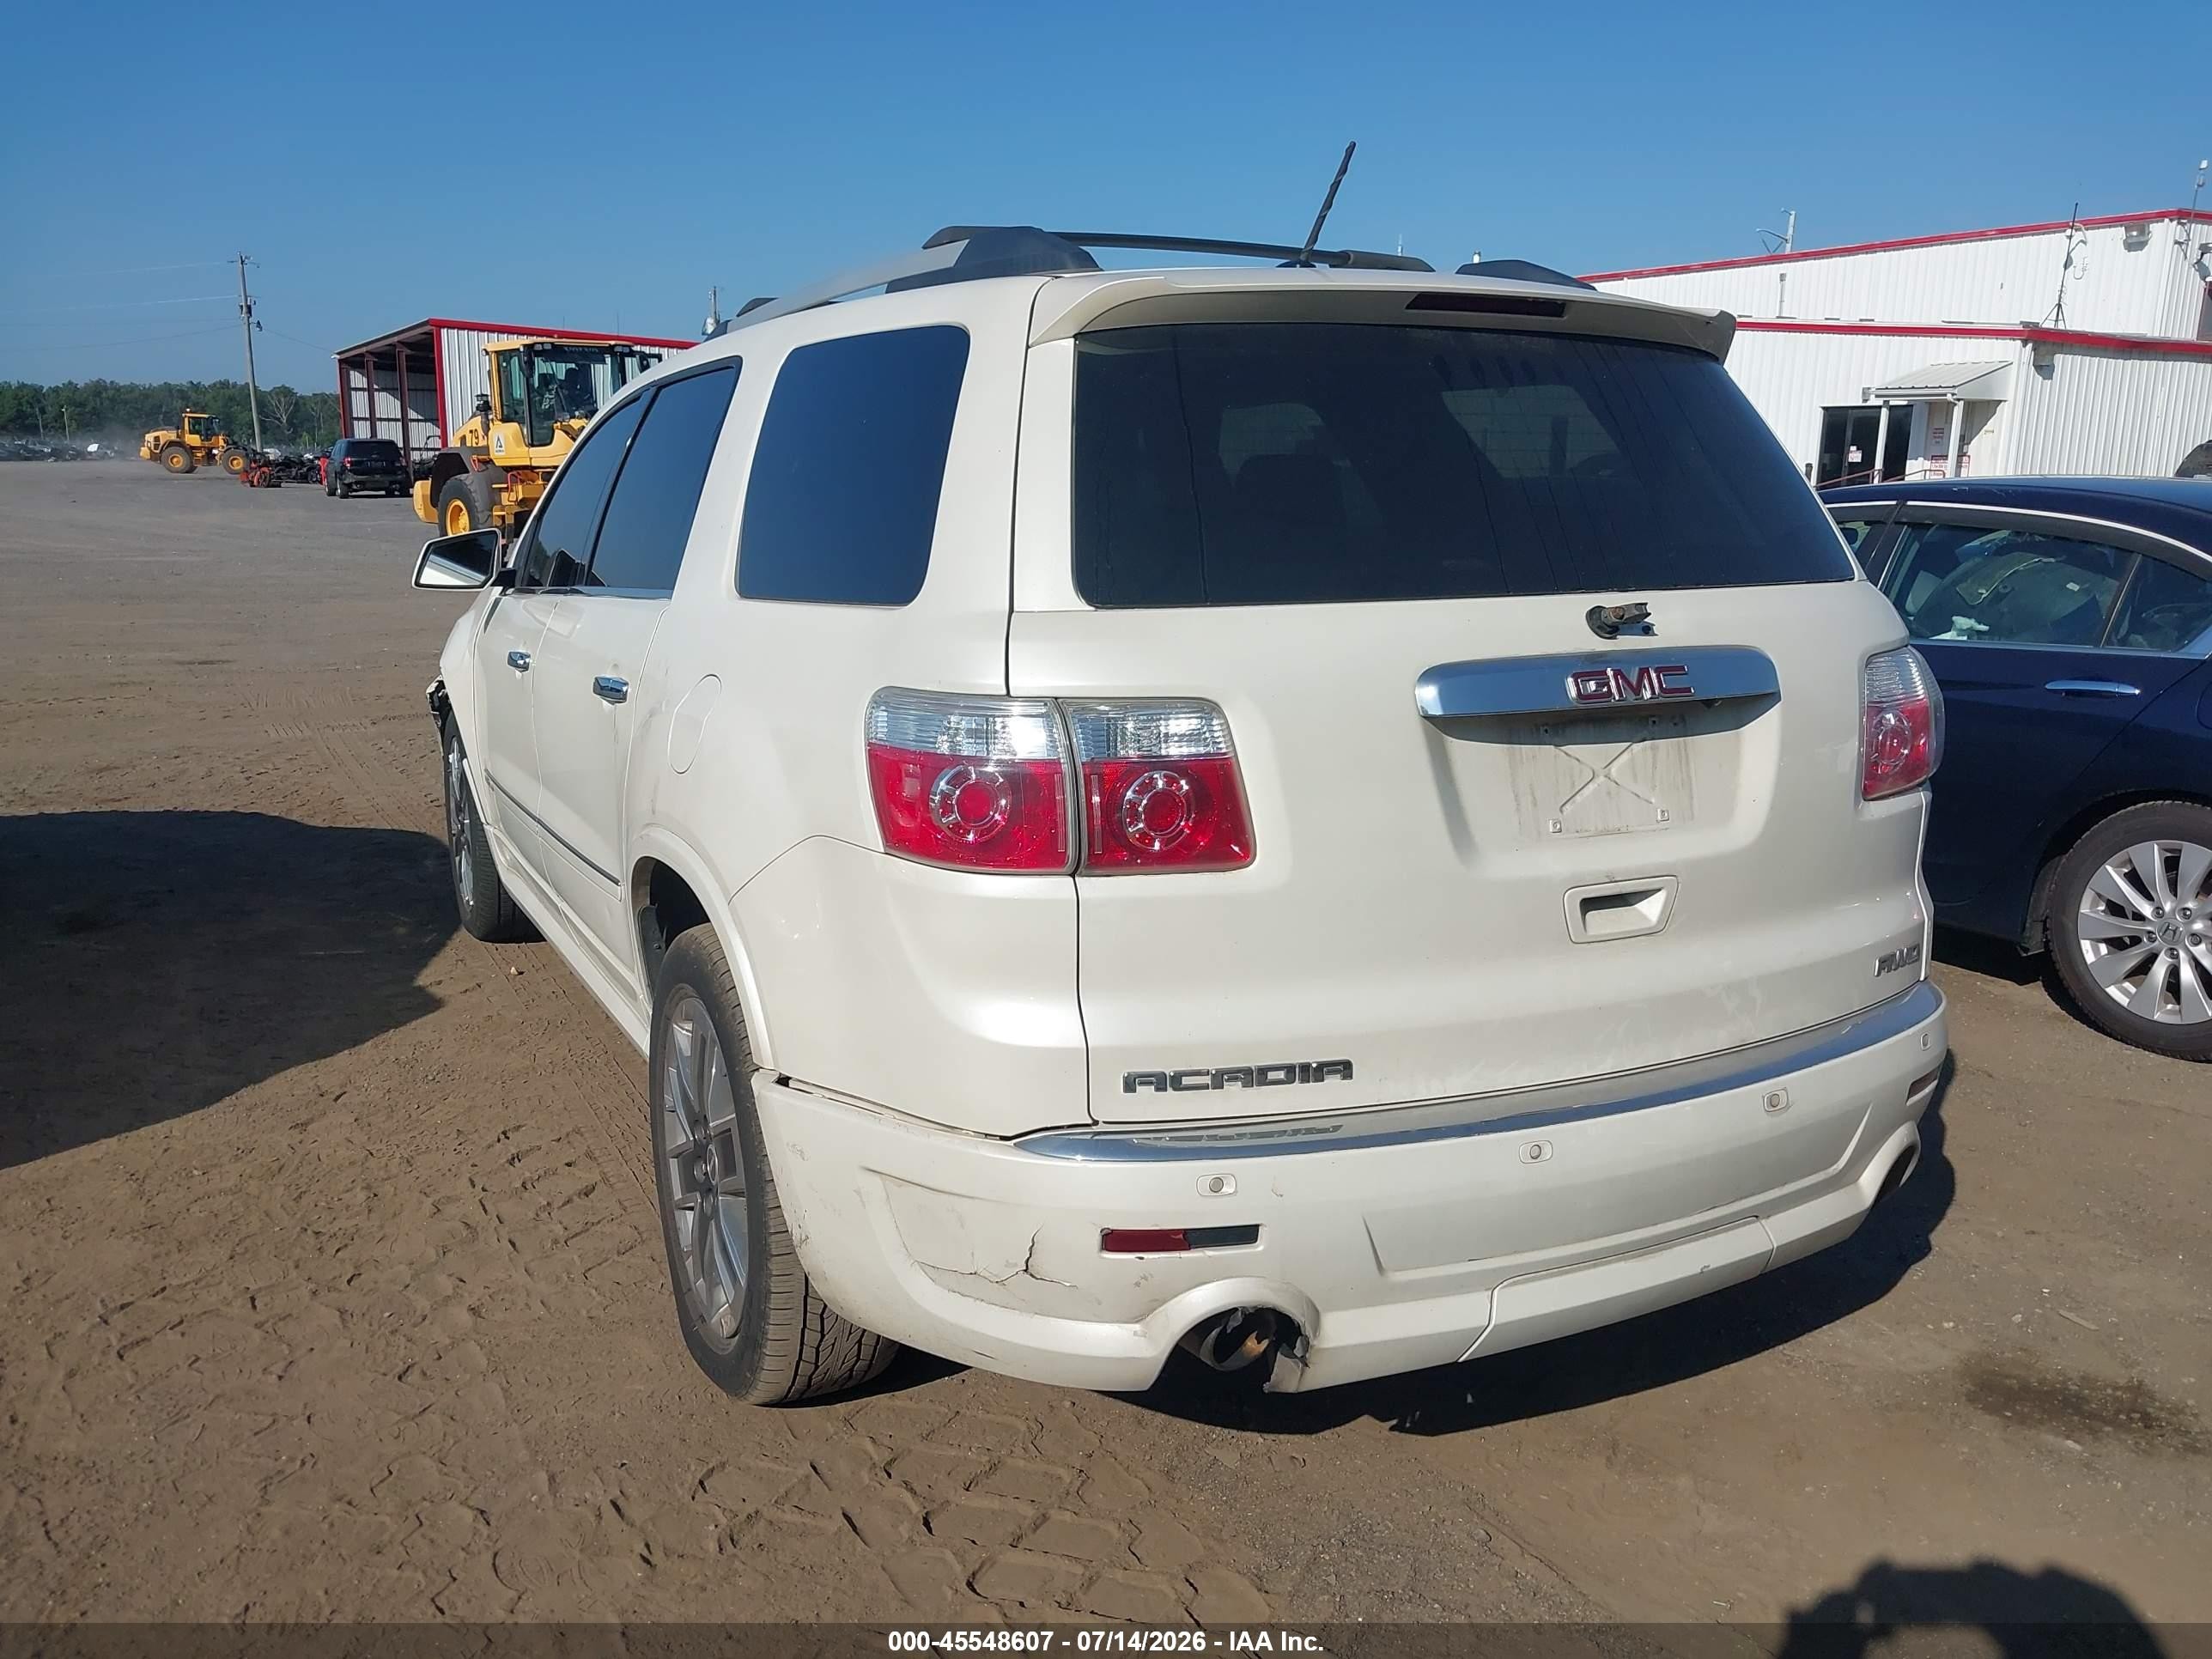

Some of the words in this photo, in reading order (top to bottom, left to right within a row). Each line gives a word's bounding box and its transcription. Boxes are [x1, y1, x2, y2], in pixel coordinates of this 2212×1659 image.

[1565, 665, 1695, 704] GMC
[1874, 944, 1920, 977] AWD
[1122, 1059, 1353, 1093] ACADIA
